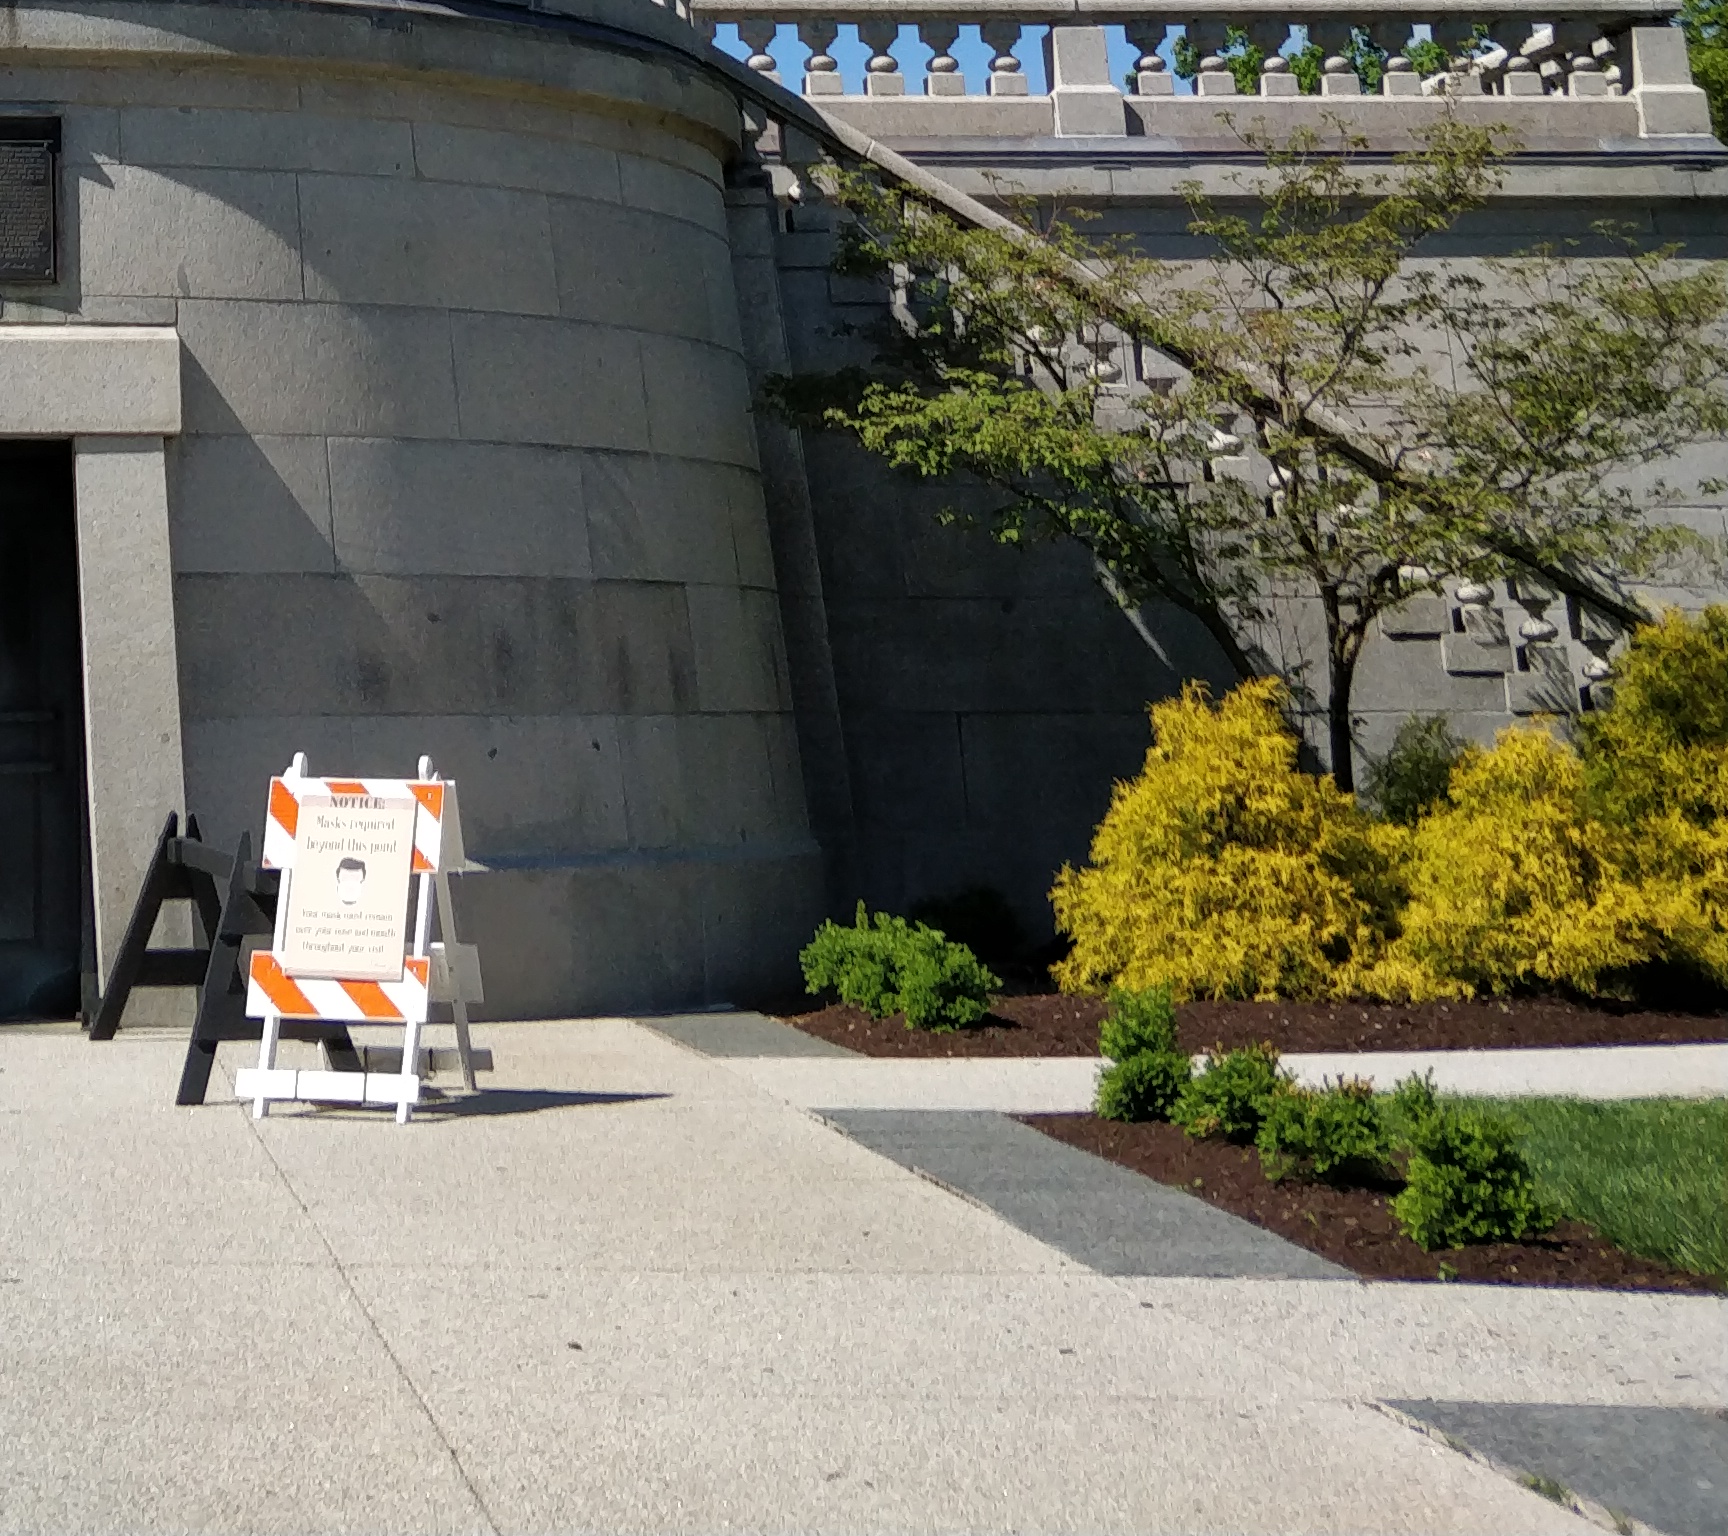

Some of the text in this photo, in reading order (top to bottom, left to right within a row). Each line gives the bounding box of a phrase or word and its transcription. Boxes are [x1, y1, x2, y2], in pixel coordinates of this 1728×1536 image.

[317, 815, 395, 832] Masks required
[307, 836, 397, 854] beyond this point
